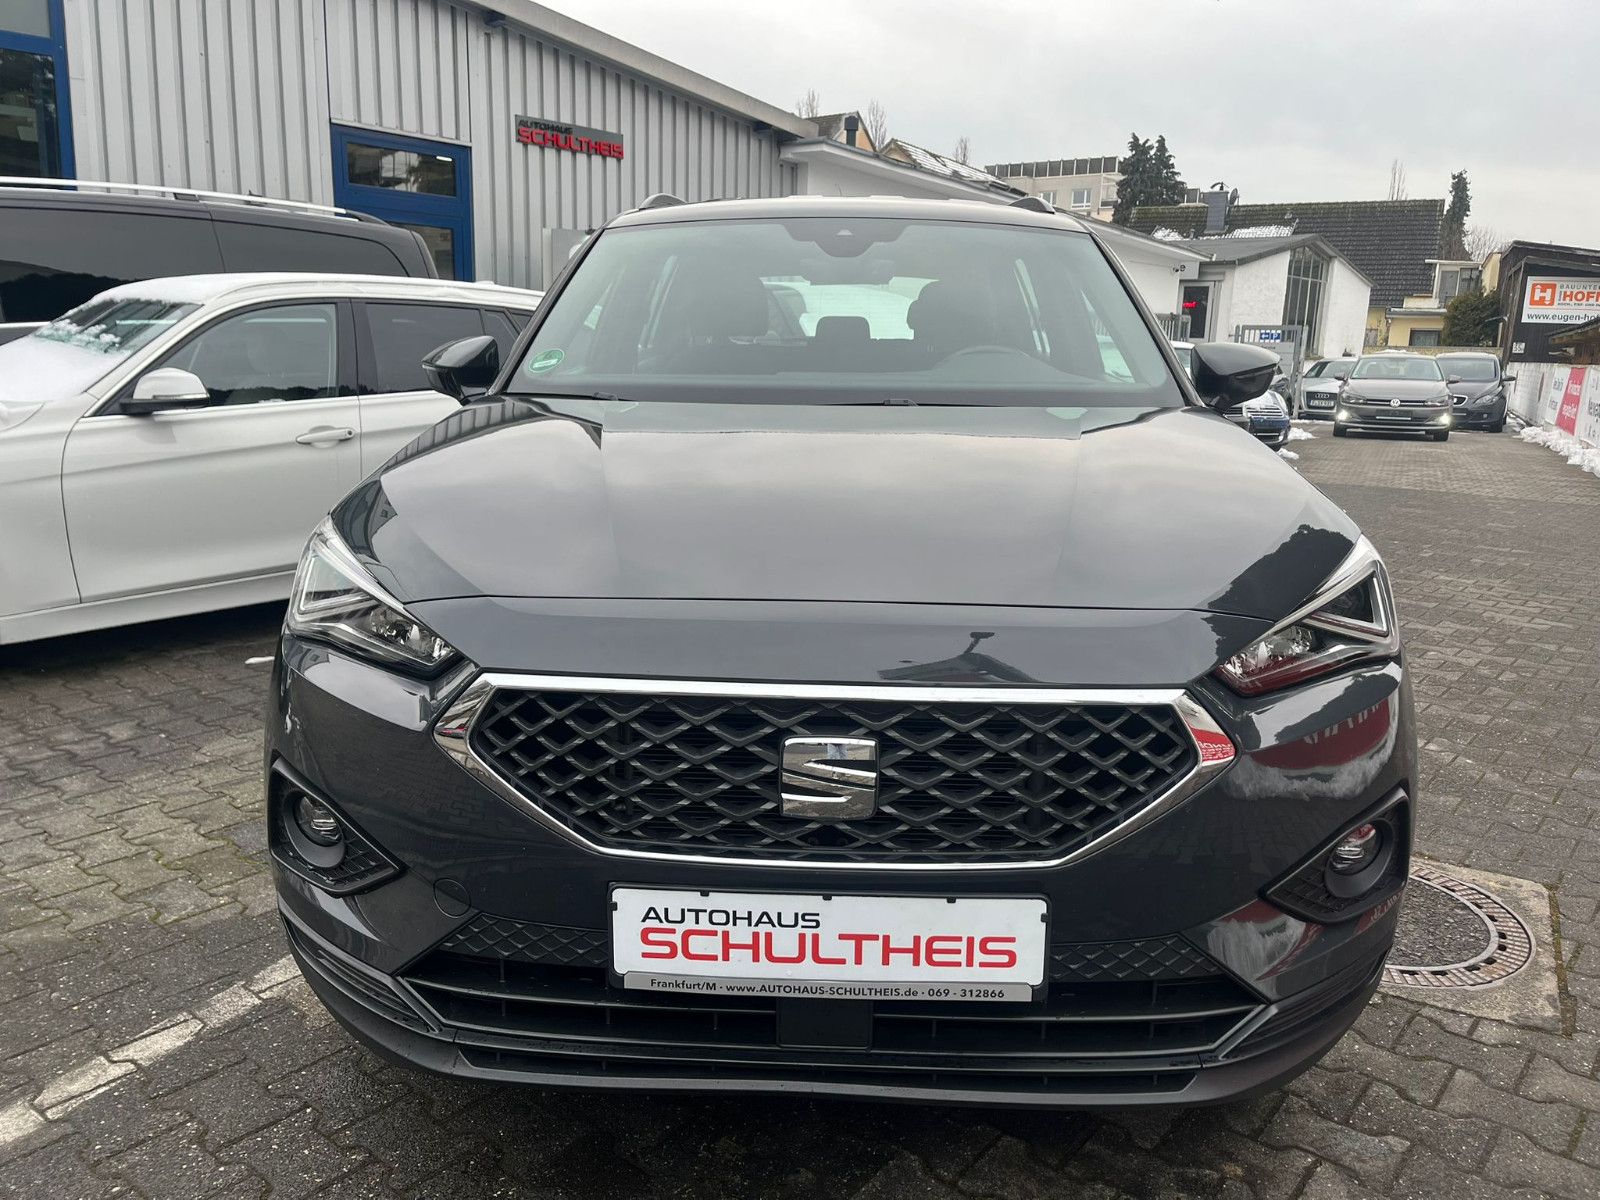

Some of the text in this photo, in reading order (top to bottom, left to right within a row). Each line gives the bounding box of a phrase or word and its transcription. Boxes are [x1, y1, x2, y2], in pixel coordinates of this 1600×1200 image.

[519, 119, 573, 134] AUTOHAUS
[517, 127, 624, 160] SCHULTHEIS
[641, 906, 820, 929] AUTOHAUS
[640, 927, 1017, 968] SCHULTHEIS
[651, 979, 1005, 998] Frankfurt/M www.AUTOHAUS-SCHULTHEIS.de 069 312866
